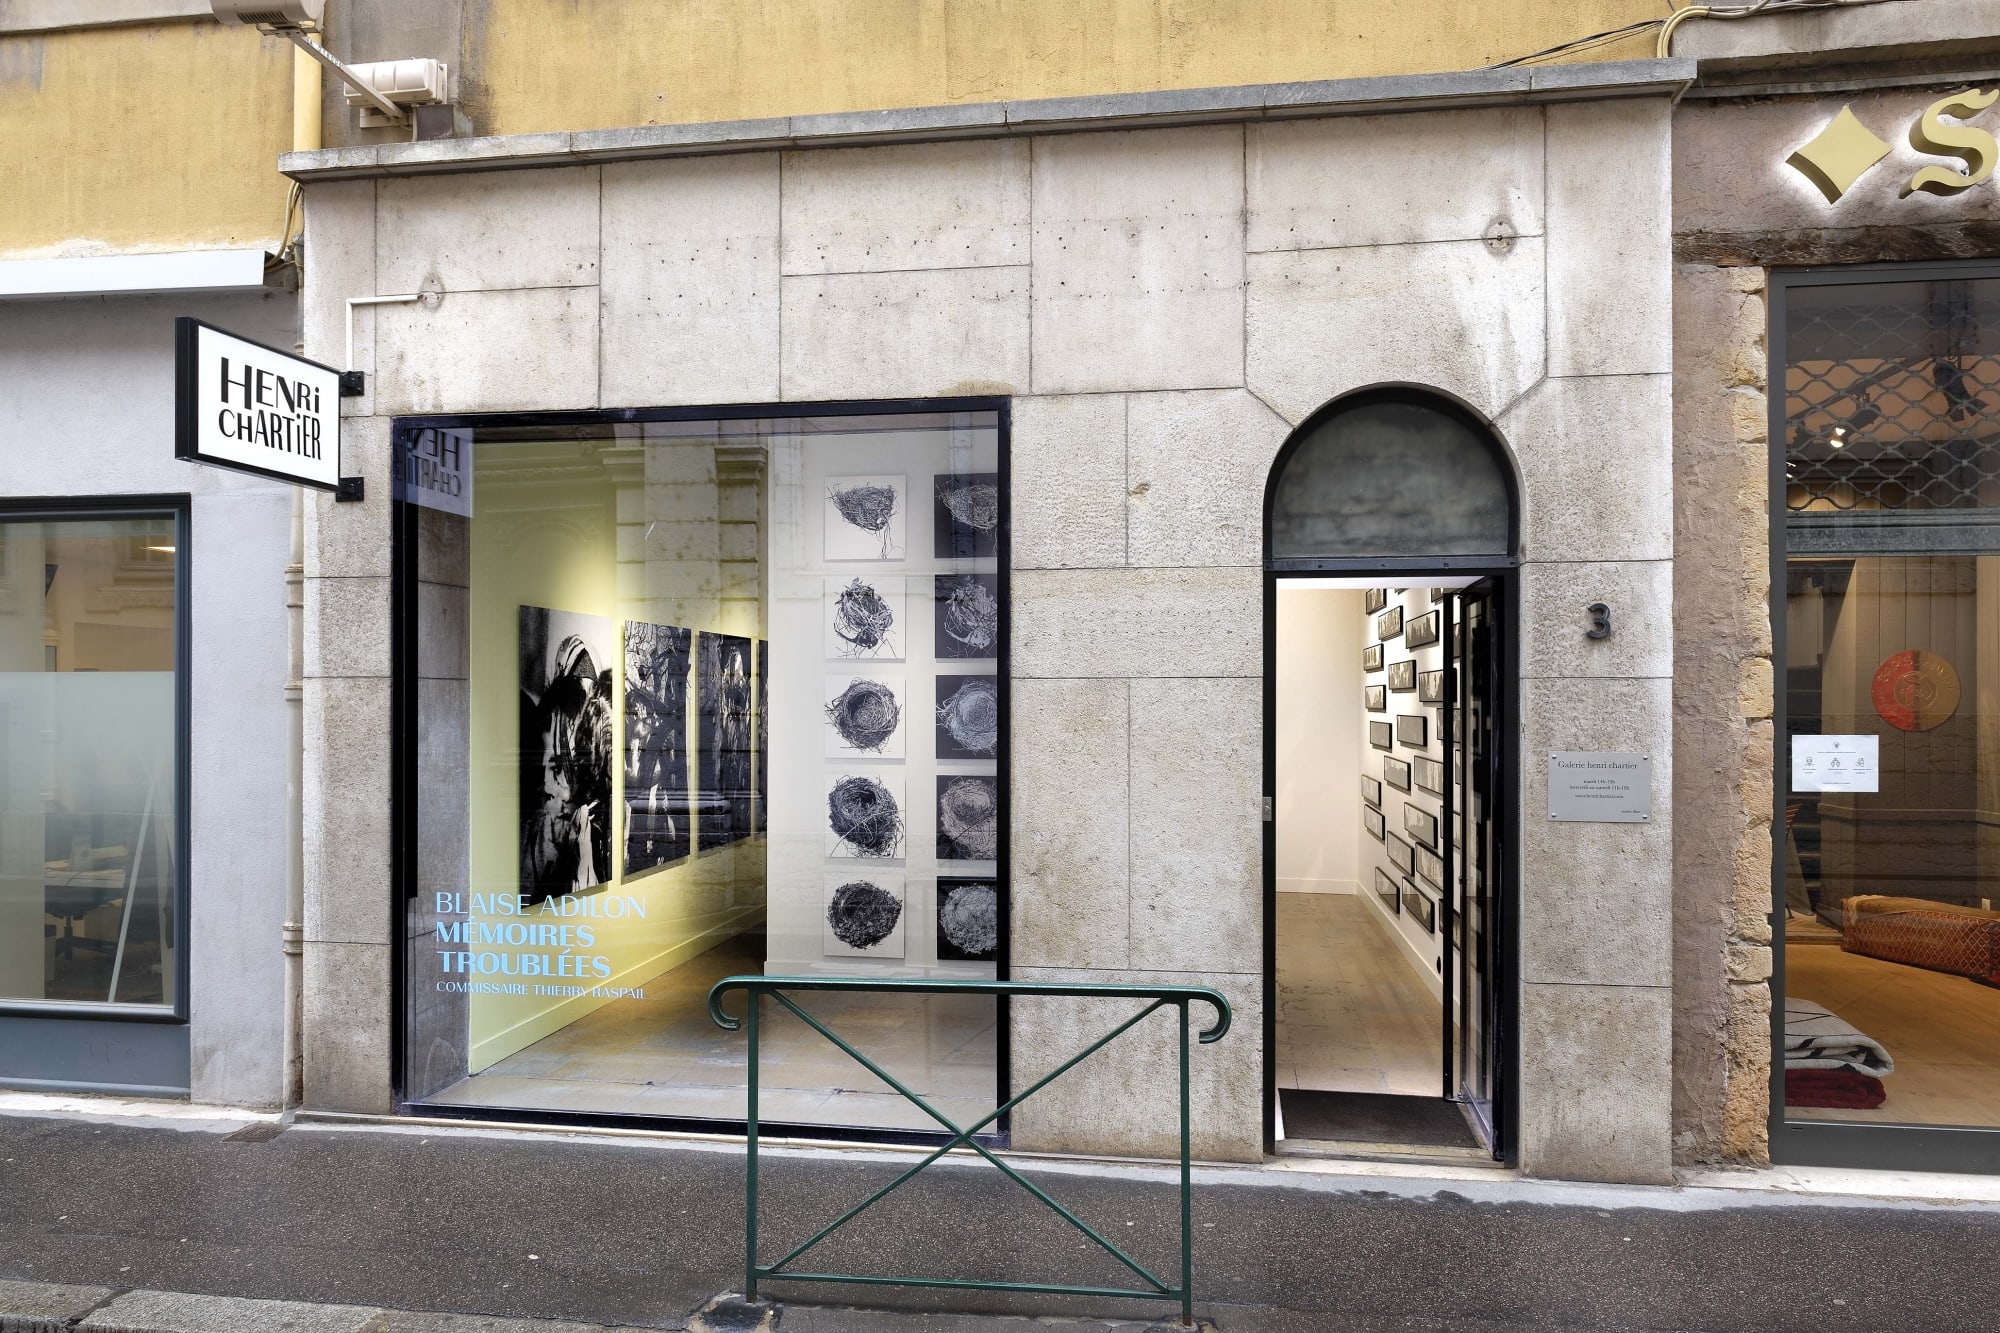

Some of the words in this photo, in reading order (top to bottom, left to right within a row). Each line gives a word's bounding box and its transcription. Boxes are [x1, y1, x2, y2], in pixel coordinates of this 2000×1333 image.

[1903, 88, 2000, 199] S
[1586, 602, 1611, 639] 3
[1558, 760, 1586, 769] Galerie
[1587, 761, 1607, 769] henri
[1608, 761, 1638, 770] chartier
[436, 891, 532, 916] BLAISE
[540, 894, 647, 919] ADILON
[436, 915, 595, 948] MÉMOIRES
[436, 948, 611, 979] TROUBLÉES
[436, 981, 529, 996] COMMISSAIRE
[532, 984, 588, 997] THIERRY
[592, 987, 647, 1000] RASPAIL
